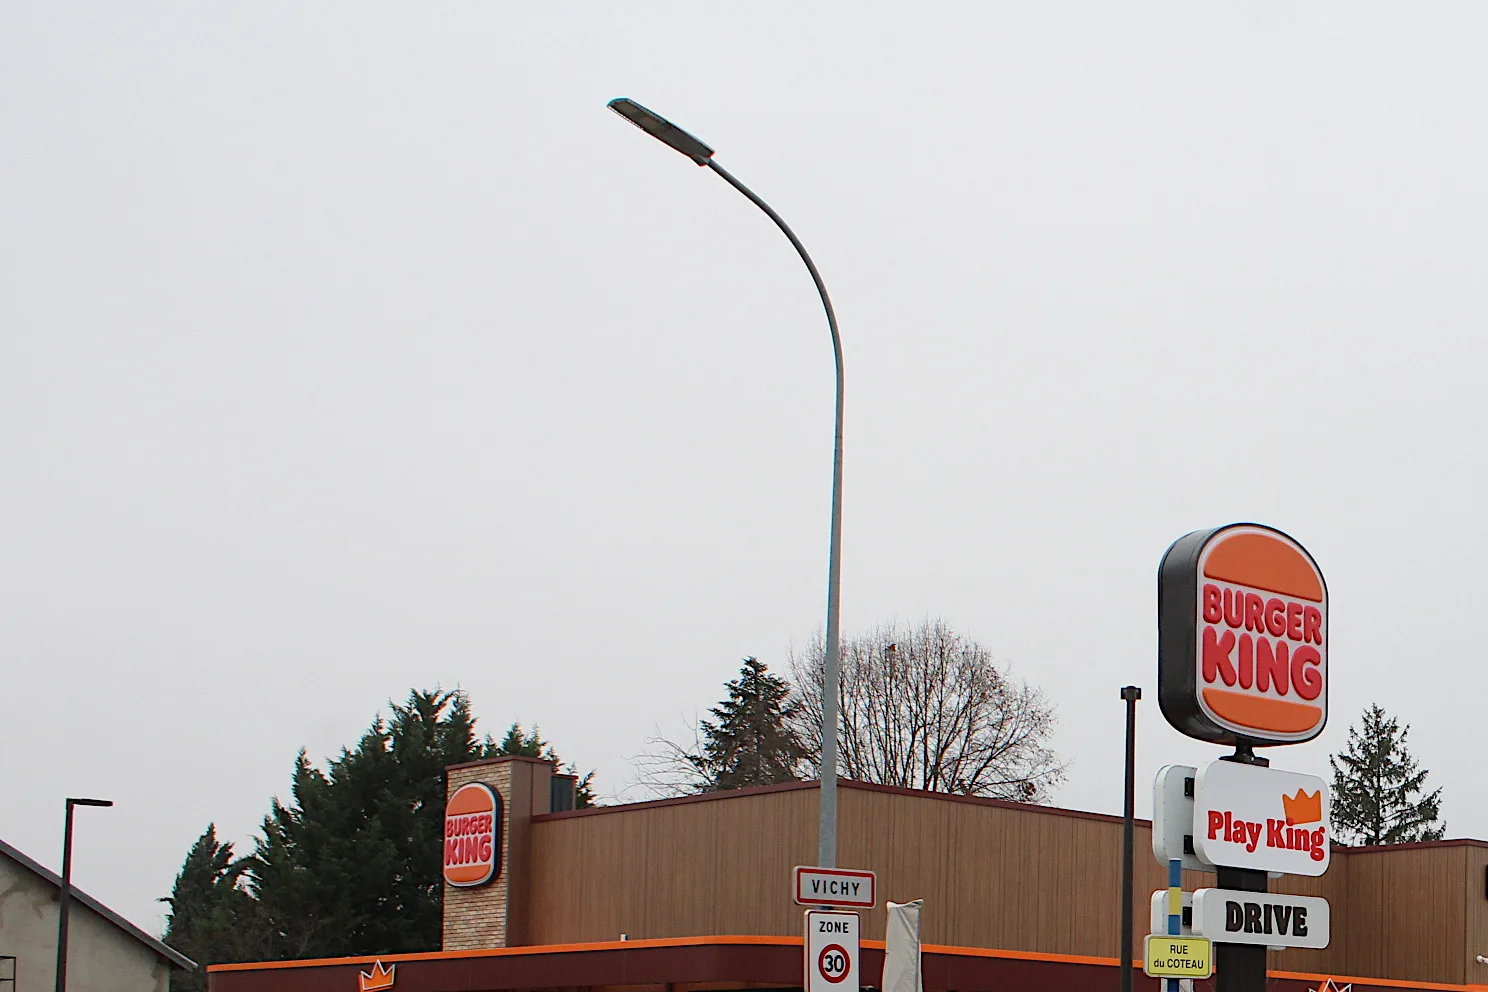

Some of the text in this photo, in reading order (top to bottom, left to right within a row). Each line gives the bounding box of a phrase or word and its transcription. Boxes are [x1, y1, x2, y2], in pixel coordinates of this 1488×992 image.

[1203, 583, 1322, 645] BURGER
[1202, 625, 1322, 701] KING
[446, 814, 493, 838] BURGER
[1207, 810, 1325, 861] Play King
[445, 834, 492, 866] KING
[812, 879, 860, 896] VICHY
[819, 921, 849, 933] ZONE
[1225, 900, 1308, 937] DRIVE
[1169, 944, 1188, 955] RUE
[824, 955, 845, 973] 30
[1153, 958, 1204, 969] du COTEAU
